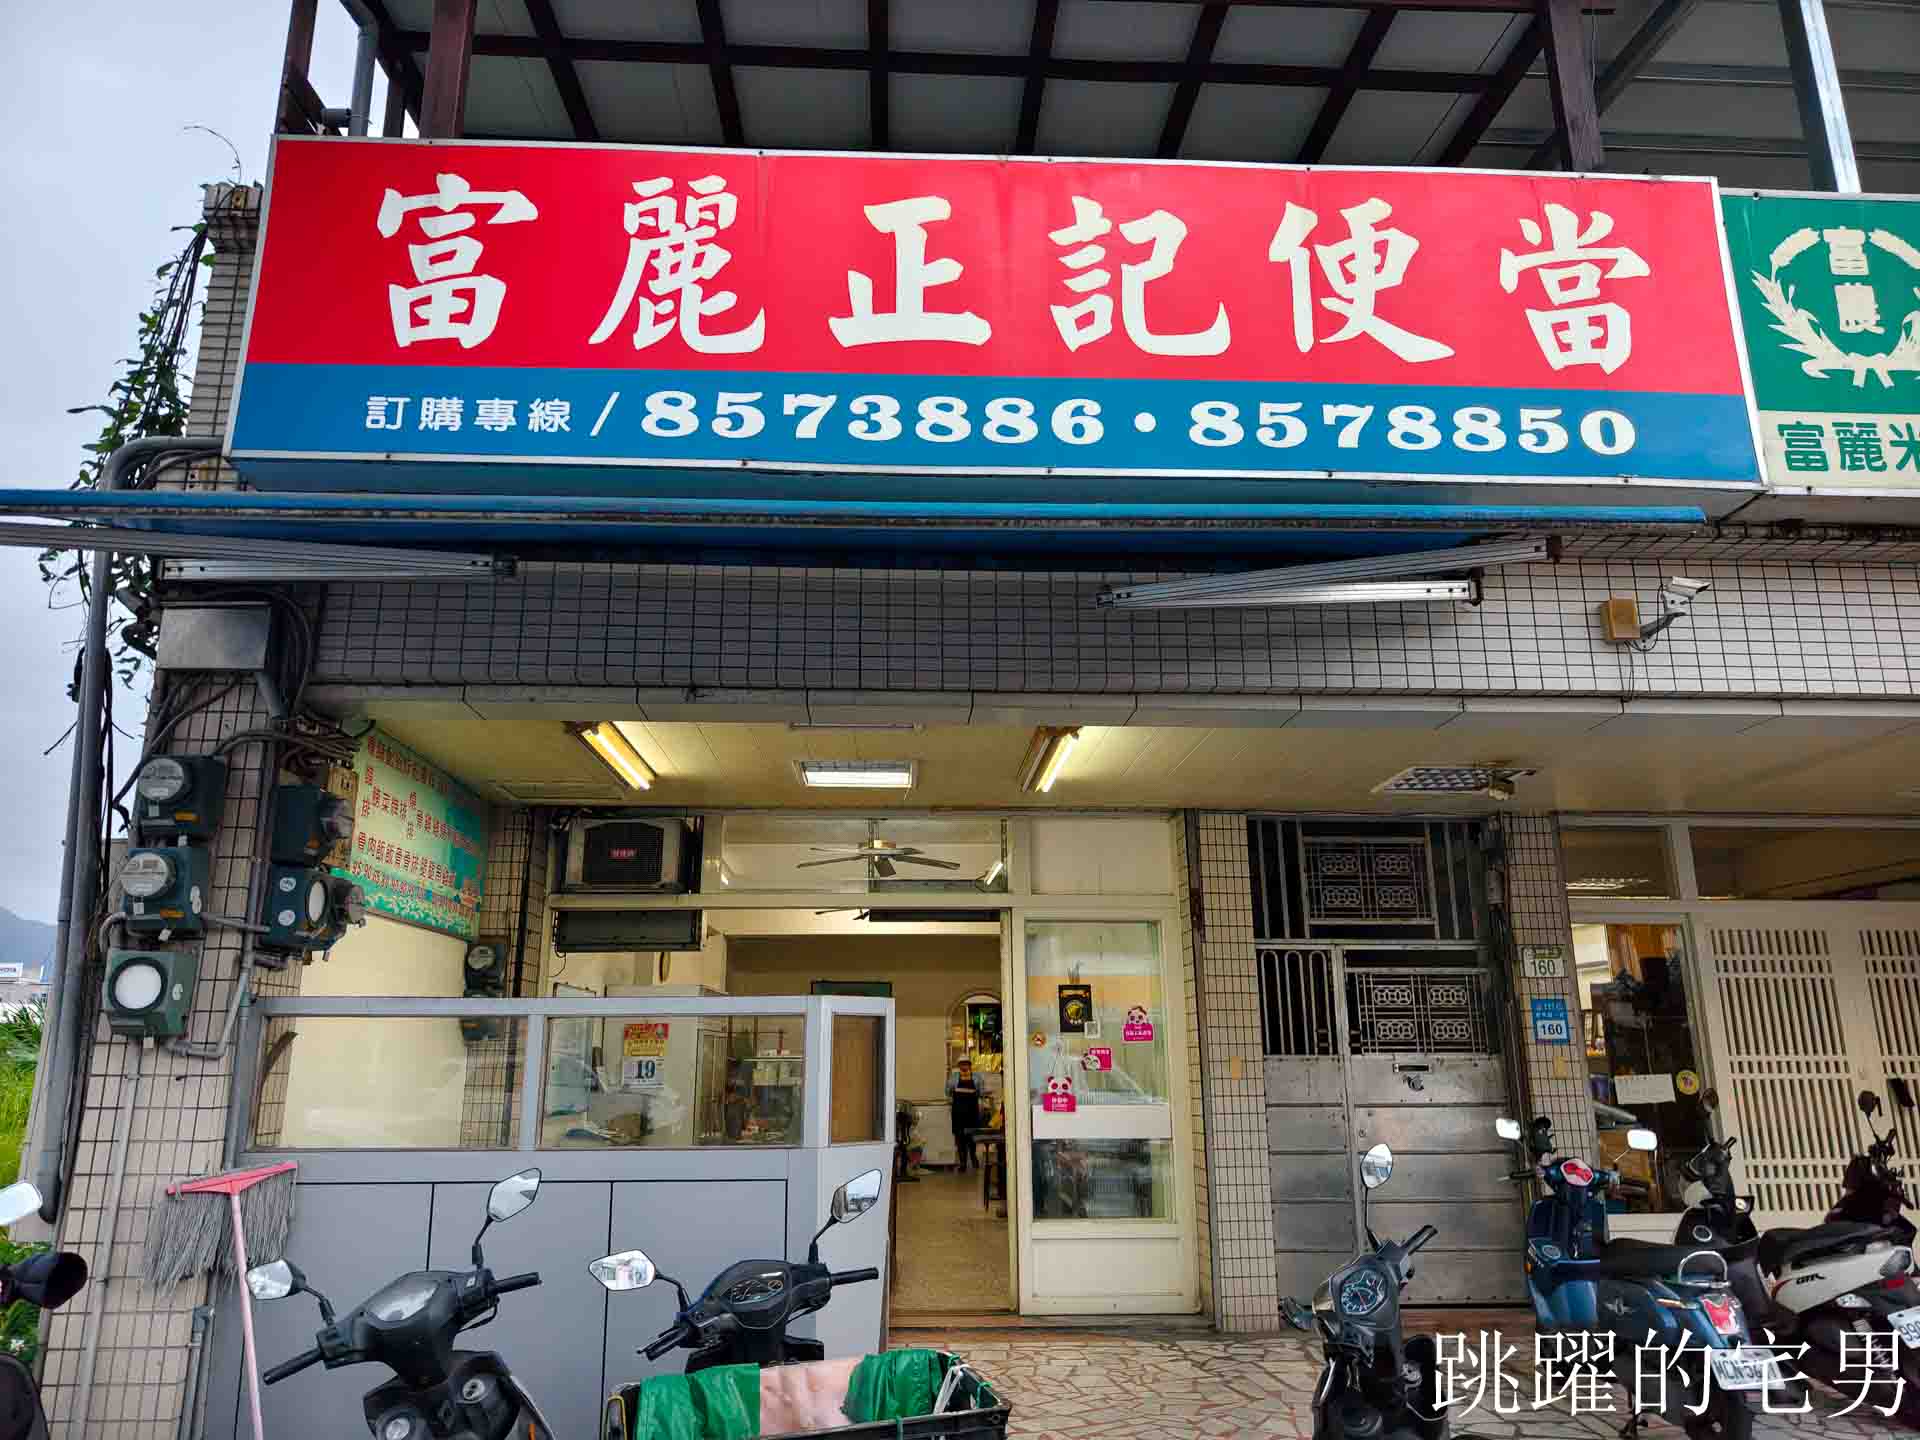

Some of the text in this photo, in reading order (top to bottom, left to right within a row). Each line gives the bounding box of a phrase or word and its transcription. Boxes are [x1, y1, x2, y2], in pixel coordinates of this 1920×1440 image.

[378, 173, 1650, 374] 富麗正記便當
[1189, 400, 1637, 456] 8578850
[1778, 421, 1920, 473] 富麗米
[1531, 959, 1556, 977] 160
[1541, 1023, 1563, 1036] 160
[634, 1060, 656, 1079] 19
